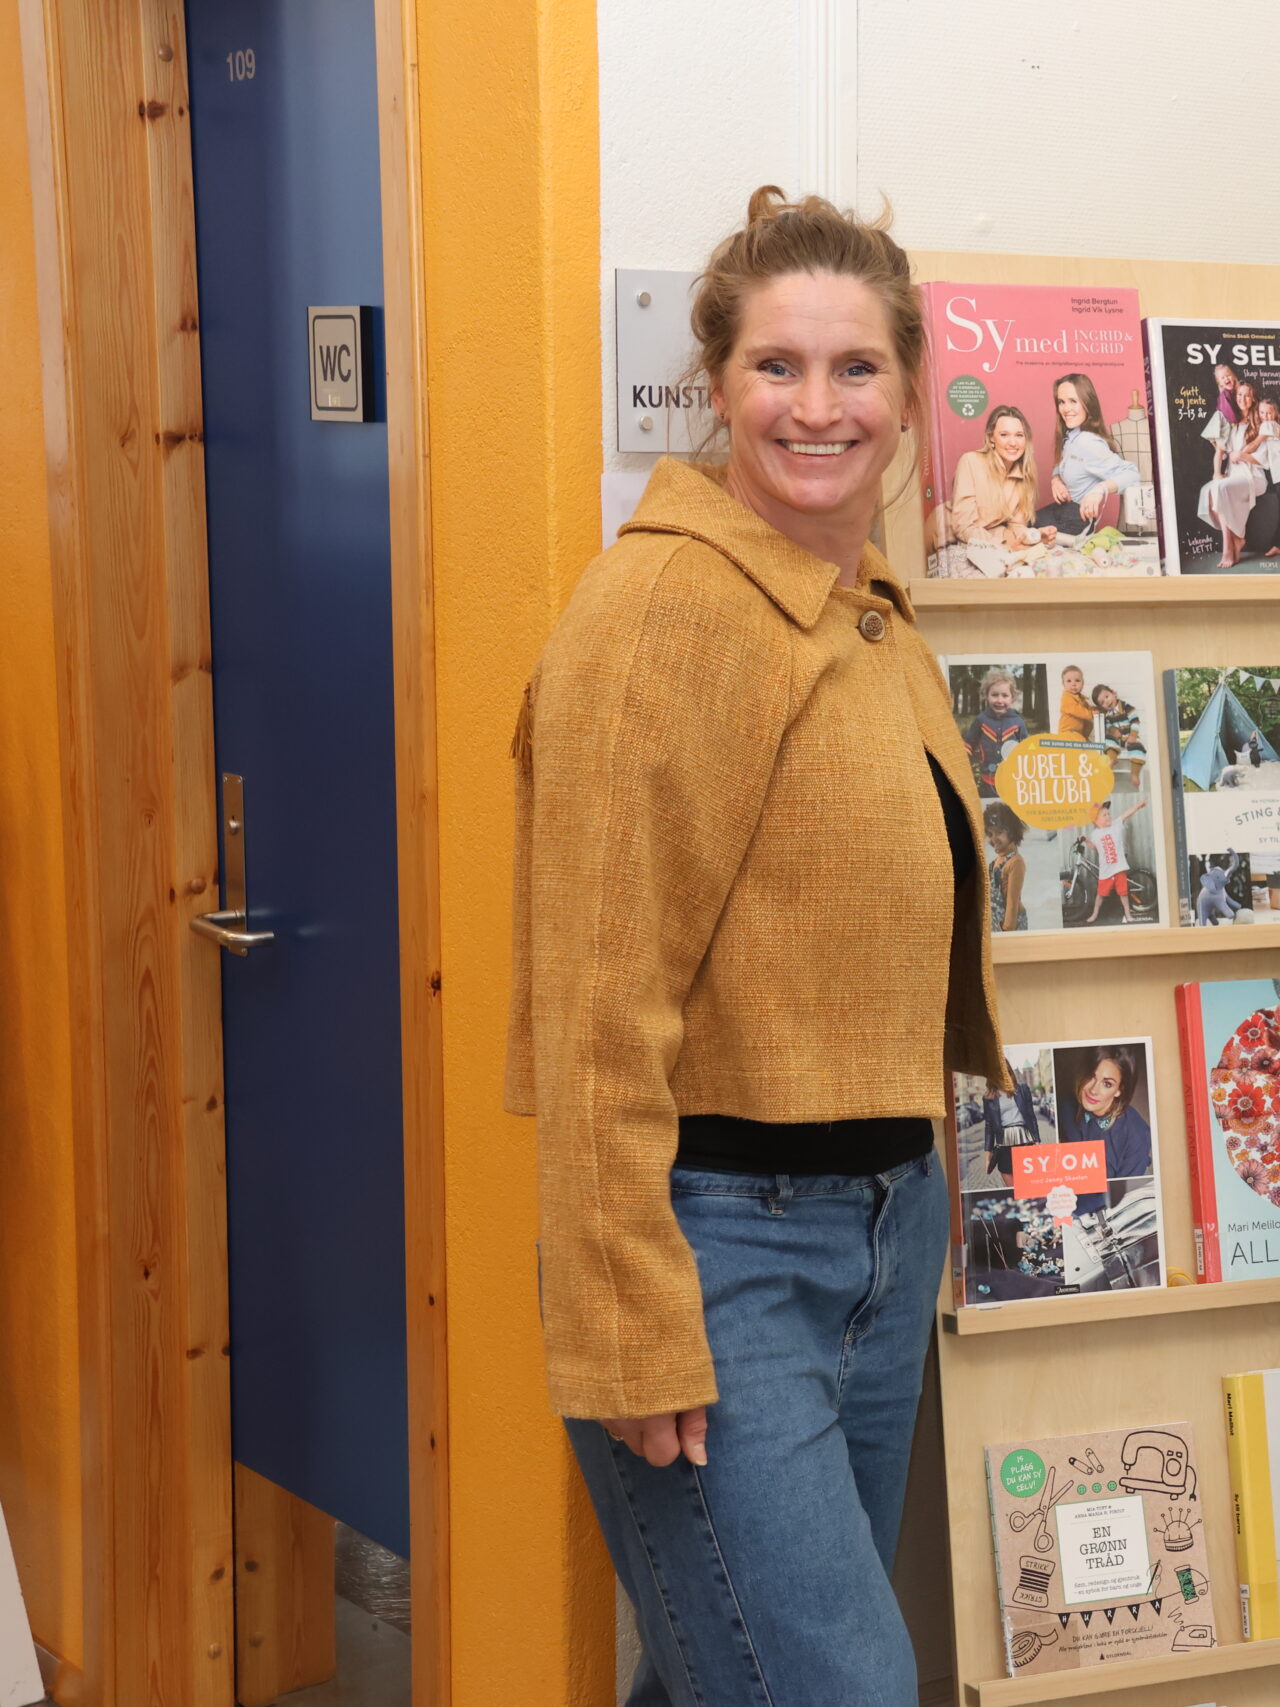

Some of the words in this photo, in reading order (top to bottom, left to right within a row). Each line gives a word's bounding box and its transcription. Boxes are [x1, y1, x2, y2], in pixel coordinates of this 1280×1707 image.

[226, 48, 256, 82] 109
[1071, 297, 1090, 305] Ingrid
[1072, 306, 1090, 314] Ingrid
[1105, 307, 1124, 315] Lysne
[946, 296, 1015, 373] Sy
[1016, 330, 1068, 353] med
[1074, 330, 1123, 341] INGRID
[1124, 332, 1134, 341] &
[1075, 342, 1124, 353] INGRID
[1187, 343, 1222, 365] SY
[319, 343, 352, 382] WC
[1180, 386, 1200, 397] Gutt
[1174, 397, 1185, 407] og
[1186, 395, 1207, 409] jente
[1178, 407, 1196, 421] 3-13
[1197, 407, 1207, 419] år
[1012, 753, 1073, 780] JUBEL
[1078, 753, 1093, 777] &
[1016, 778, 1092, 806] BALUBA
[1235, 807, 1273, 826] STING
[1023, 1157, 1049, 1174] SY
[1062, 1153, 1098, 1170] OM
[1228, 1222, 1249, 1233] Mari
[1006, 1476, 1016, 1485] DU
[1018, 1473, 1031, 1482] KAN
[1032, 1469, 1042, 1478] SY
[1092, 1526, 1111, 1539] EN
[1079, 1539, 1127, 1556] GRØNN
[1024, 1560, 1050, 1571] STRIKK
[1085, 1554, 1125, 1570] TRÅD
[1019, 1592, 1043, 1603] STRIKK
